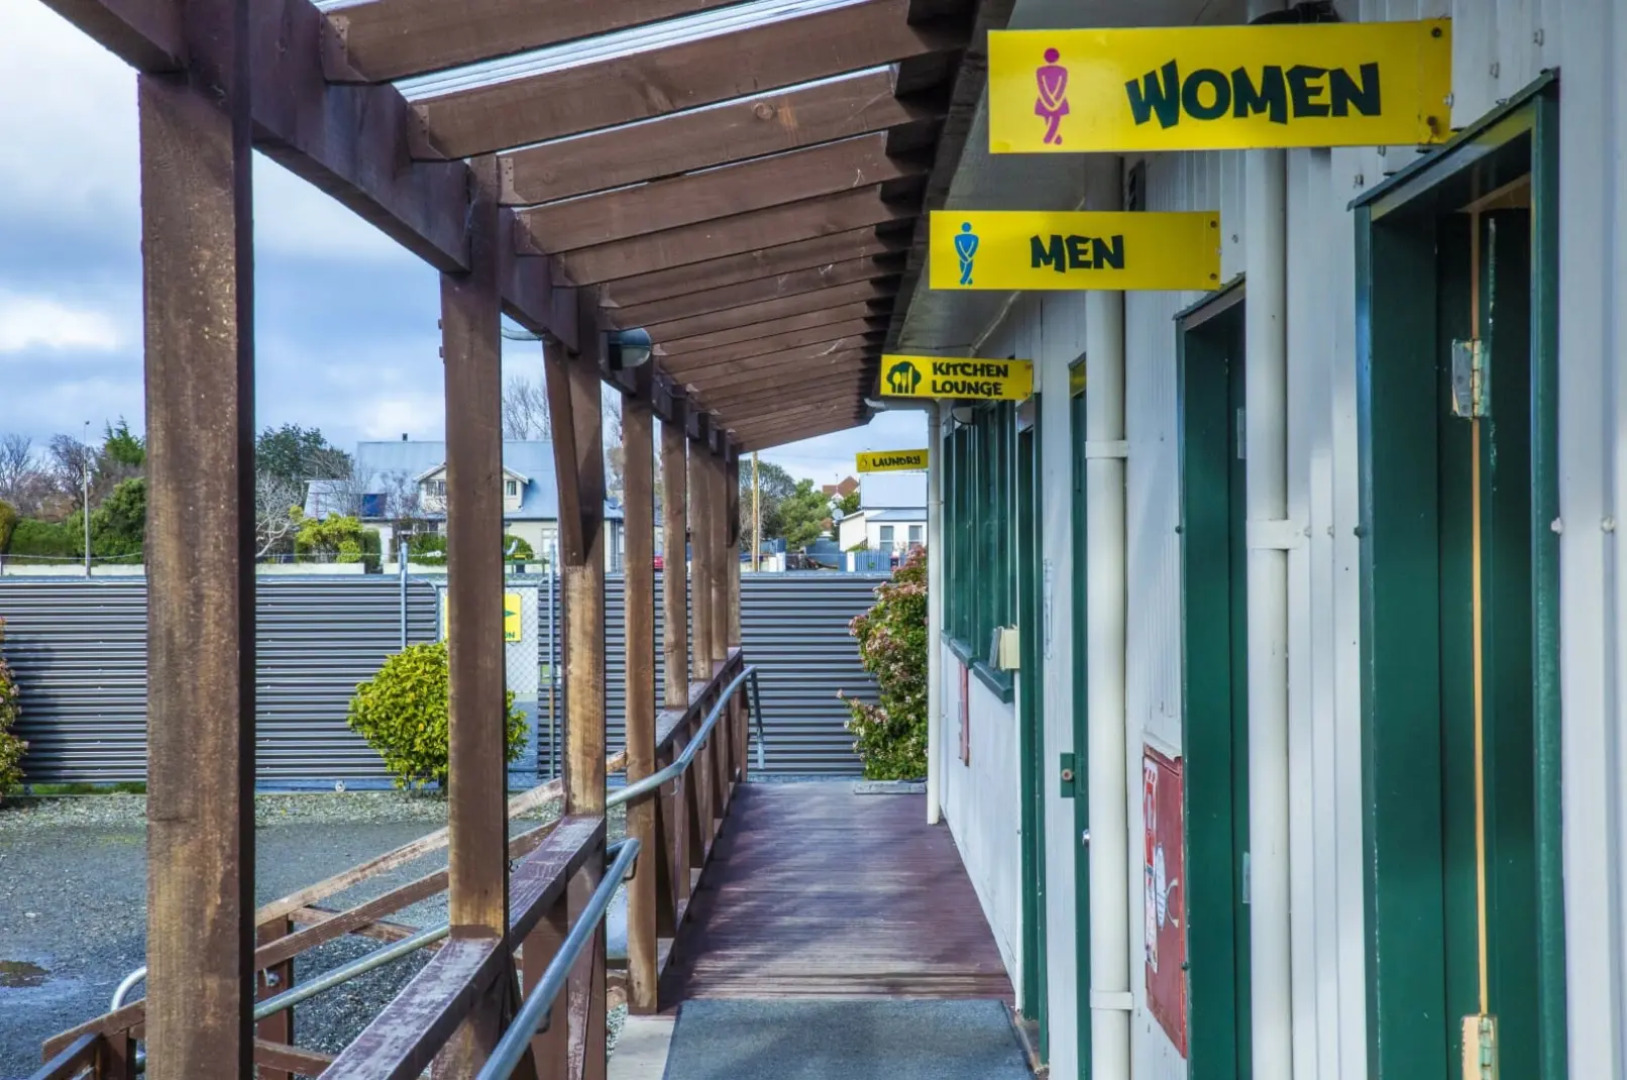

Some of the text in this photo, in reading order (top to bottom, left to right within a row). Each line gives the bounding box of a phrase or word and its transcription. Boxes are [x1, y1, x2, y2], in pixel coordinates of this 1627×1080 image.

[1125, 59, 1382, 129] WOMEN
[1031, 234, 1125, 274] MEN
[932, 362, 1009, 378] KITCHEN
[932, 380, 1004, 397] LOUNGE
[872, 455, 921, 467] LAUNDRY
